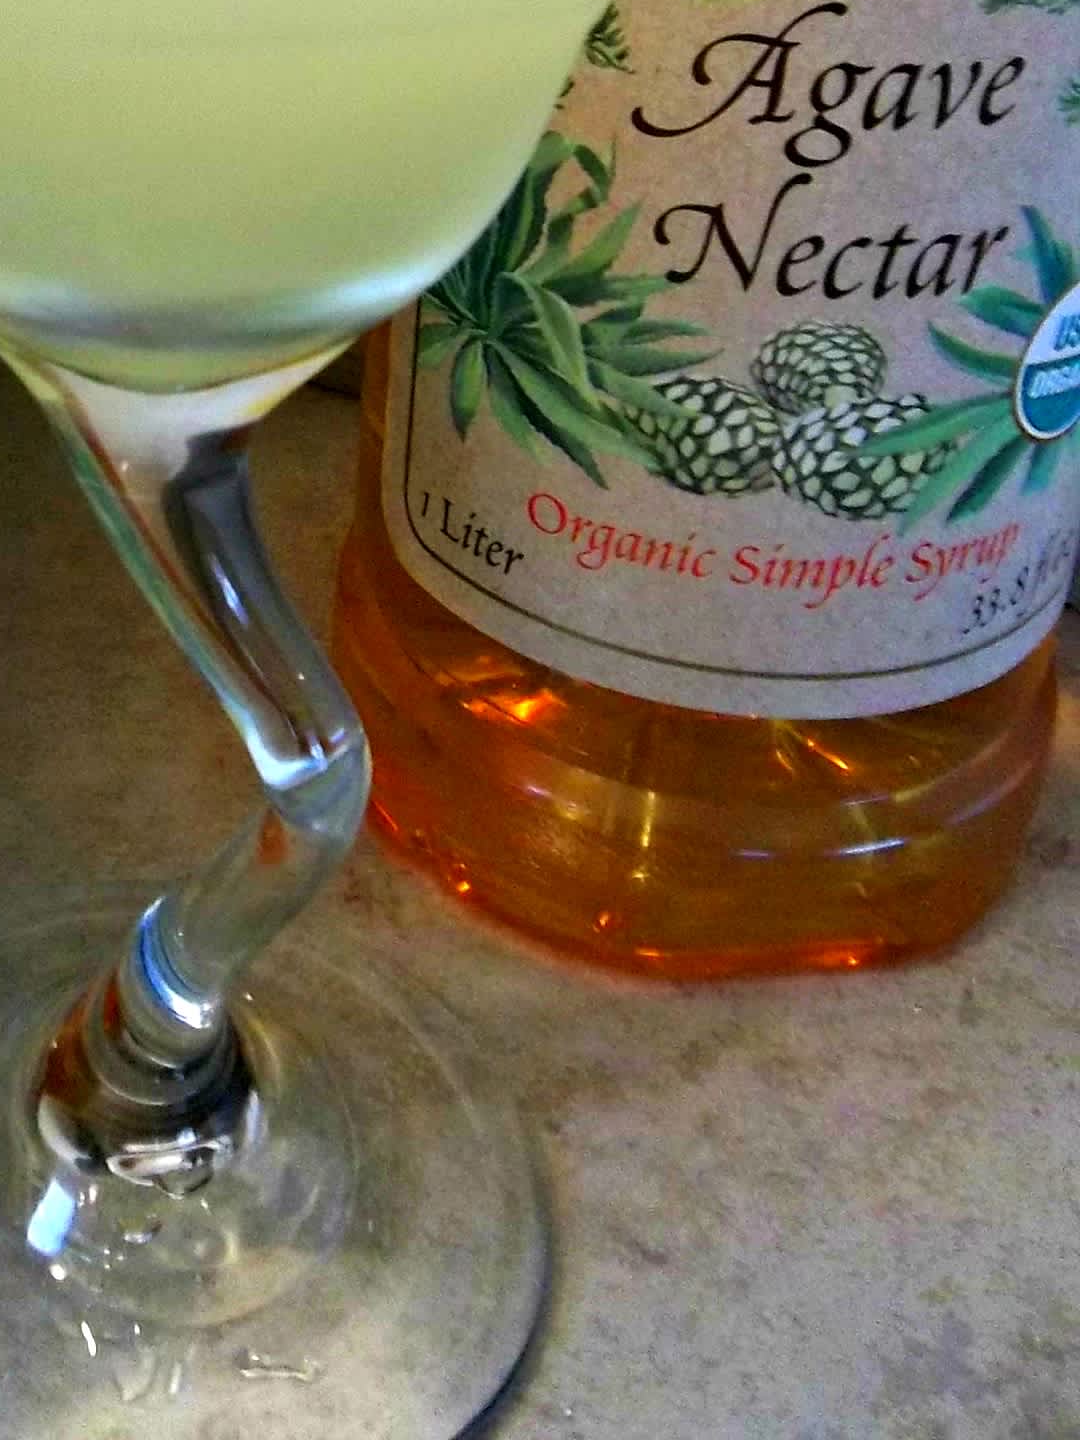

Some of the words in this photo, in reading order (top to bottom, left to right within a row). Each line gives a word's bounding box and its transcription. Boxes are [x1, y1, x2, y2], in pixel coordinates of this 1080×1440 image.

[631, 2, 1025, 167] Agave
[653, 172, 1009, 300] Nectar
[440, 497, 525, 575] Liter
[526, 492, 717, 578] Organic
[728, 532, 895, 609] Simple
[905, 522, 1021, 602] Syrup
